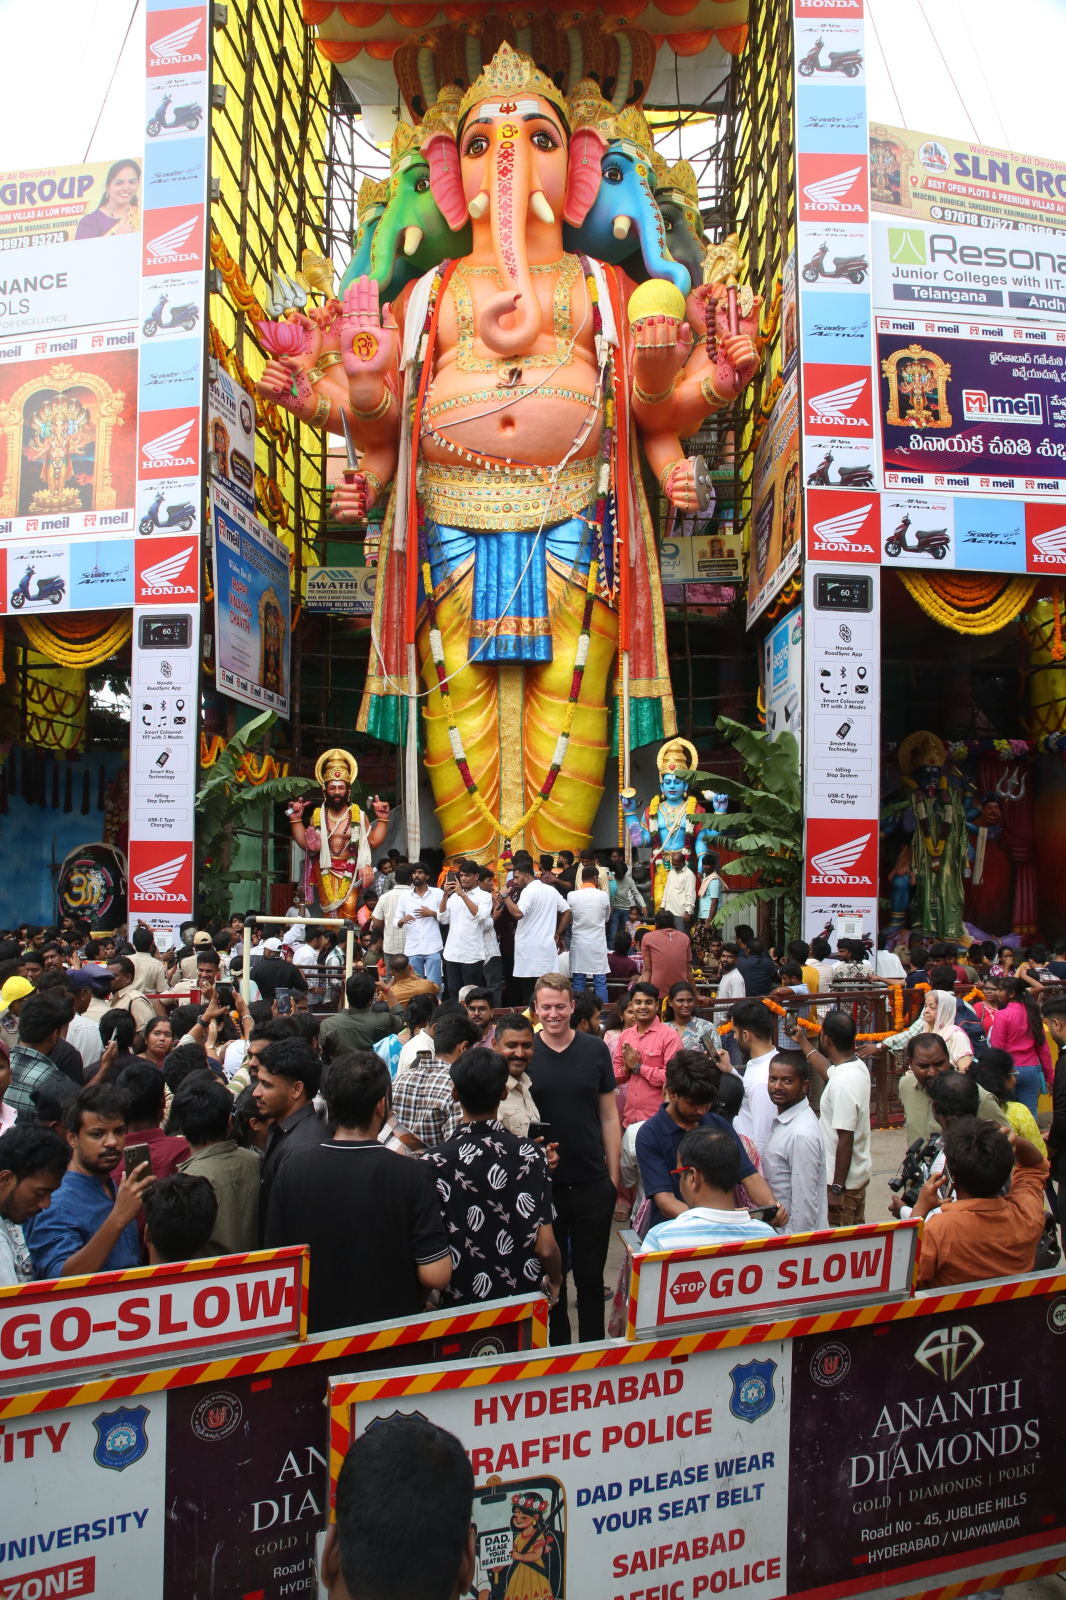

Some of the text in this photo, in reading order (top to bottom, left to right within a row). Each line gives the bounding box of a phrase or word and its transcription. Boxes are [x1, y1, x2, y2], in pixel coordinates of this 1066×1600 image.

[800, 0, 860, 8] HONDA
[150, 54, 202, 66] HONDA
[969, 145, 1008, 159] Welcome
[1010, 153, 1019, 162] To
[1022, 156, 1032, 164] All
[953, 152, 1010, 186] SLN
[0, 175, 94, 206] GROUP
[927, 178, 947, 191] BEST
[948, 183, 966, 195] OPEN
[968, 187, 990, 200] PLOTS
[991, 191, 997, 200] &
[998, 192, 1030, 206] PREMIUM
[1031, 199, 1055, 211] VILLAS
[13, 205, 84, 219] VILLAS LOW PRICES
[804, 202, 864, 212] HONDA
[944, 210, 979, 226] 97018
[146, 252, 200, 266] HONDA
[892, 266, 941, 280] Junior
[943, 269, 1007, 286] Colleges
[1012, 275, 1041, 288] with
[911, 286, 987, 303] Telangana
[17, 314, 69, 327] EXCELLENCE
[892, 320, 1047, 341] meil meil meil meil
[50, 338, 78, 353] meil
[106, 332, 135, 346] meil
[992, 396, 1040, 416] meil
[809, 415, 871, 427] HONDA
[910, 434, 1031, 455] వినాయక చవితి
[142, 457, 196, 470] HONDA
[901, 475, 1059, 490] meil meil meil meil
[41, 512, 129, 531] meil meil
[967, 530, 1001, 538] Scooter
[813, 542, 875, 554] HONDA
[141, 584, 196, 597] HONDA
[811, 875, 872, 884] HONDA
[133, 892, 188, 902] HONDA
[672, 1248, 882, 1299] STOP GO SLOW
[0, 1276, 287, 1360] GO-SLOW
[474, 1368, 684, 1427] HYDERABAD
[871, 1378, 1023, 1438] ANANTH
[0, 1422, 71, 1463] ITY
[466, 1408, 712, 1476] RAFFIC POLICE
[848, 1419, 1041, 1489] DIAMONDS
[576, 1451, 775, 1507] DAD PLEASE WEAR
[852, 1462, 1037, 1515] GOLD DIAMONDS POLKI
[592, 1483, 765, 1535] YOUR SEAT BELT
[861, 1492, 1027, 1542] Road No 45, JUBLIEE HILLS
[255, 1535, 297, 1557] GOLD
[485, 1534, 510, 1546] DAD,
[486, 1543, 507, 1552] PLEASE
[867, 1534, 940, 1564] HYDERABAD
[951, 1515, 1020, 1542] VIJAYAWADA
[612, 1528, 745, 1579] SAIFABAD
[273, 1559, 305, 1579] Road
[693, 1557, 780, 1599] POLICE
[4, 1567, 84, 1600] ZONE
